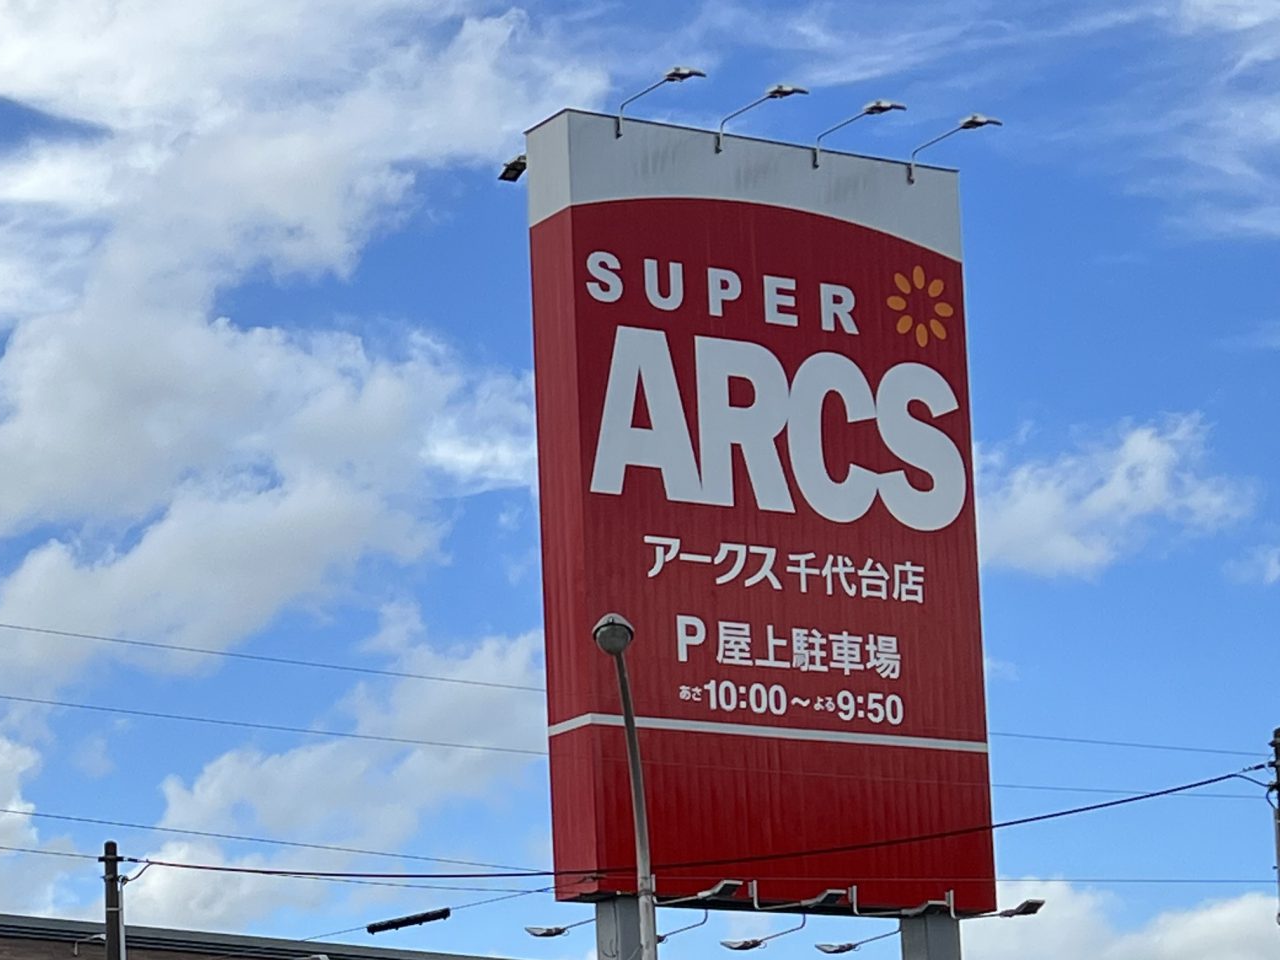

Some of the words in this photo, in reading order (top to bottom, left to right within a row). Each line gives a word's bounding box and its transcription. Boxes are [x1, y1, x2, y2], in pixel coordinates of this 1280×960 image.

[586, 251, 859, 335] SUPER
[590, 325, 967, 532] ARCS
[676, 614, 707, 663] P
[716, 620, 902, 680] 屋上駐車場
